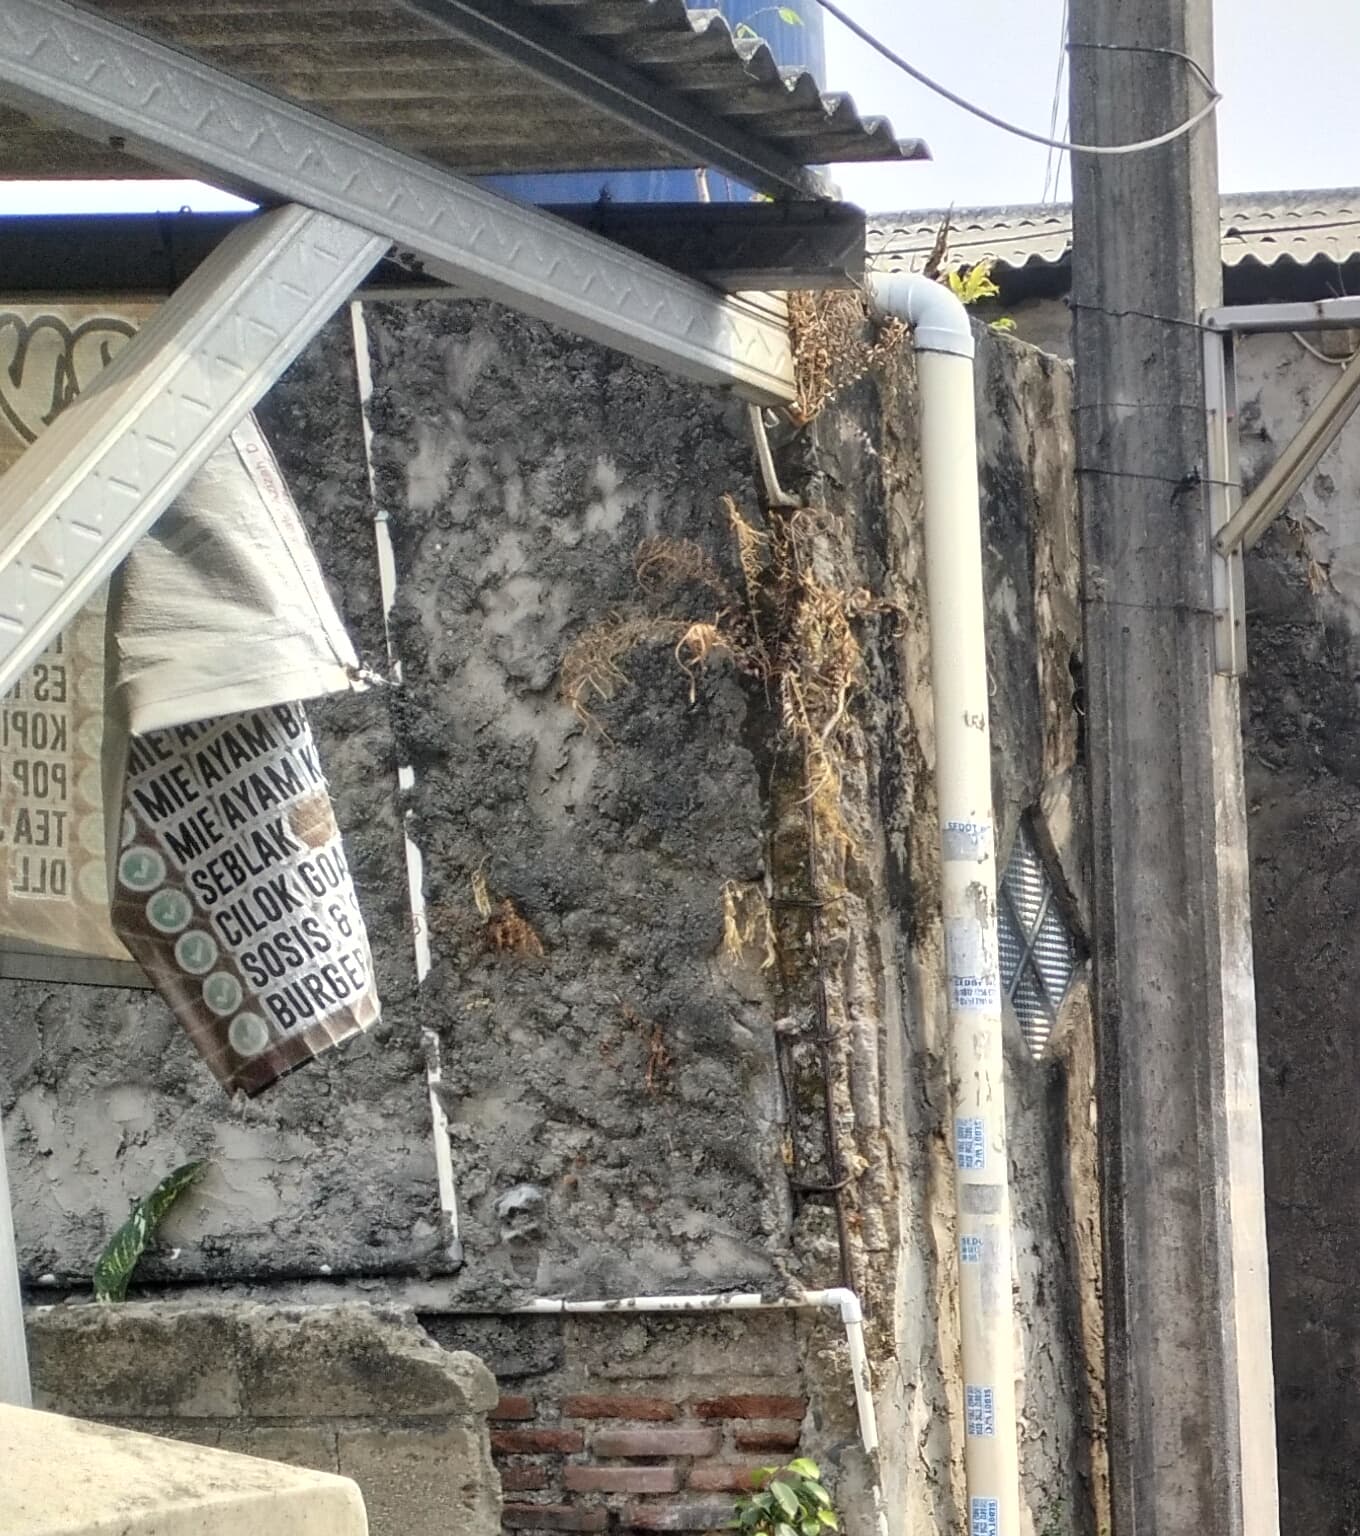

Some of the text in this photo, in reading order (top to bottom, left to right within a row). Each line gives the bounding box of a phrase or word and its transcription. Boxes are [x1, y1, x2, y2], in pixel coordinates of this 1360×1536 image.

[133, 764, 200, 823] MIE
[196, 713, 279, 789] AYAM
[163, 806, 225, 865] MIE
[218, 757, 305, 831] AYAM
[191, 816, 301, 905] SEBLAK
[215, 873, 304, 947] CILOK
[240, 903, 353, 988] SOSIS &
